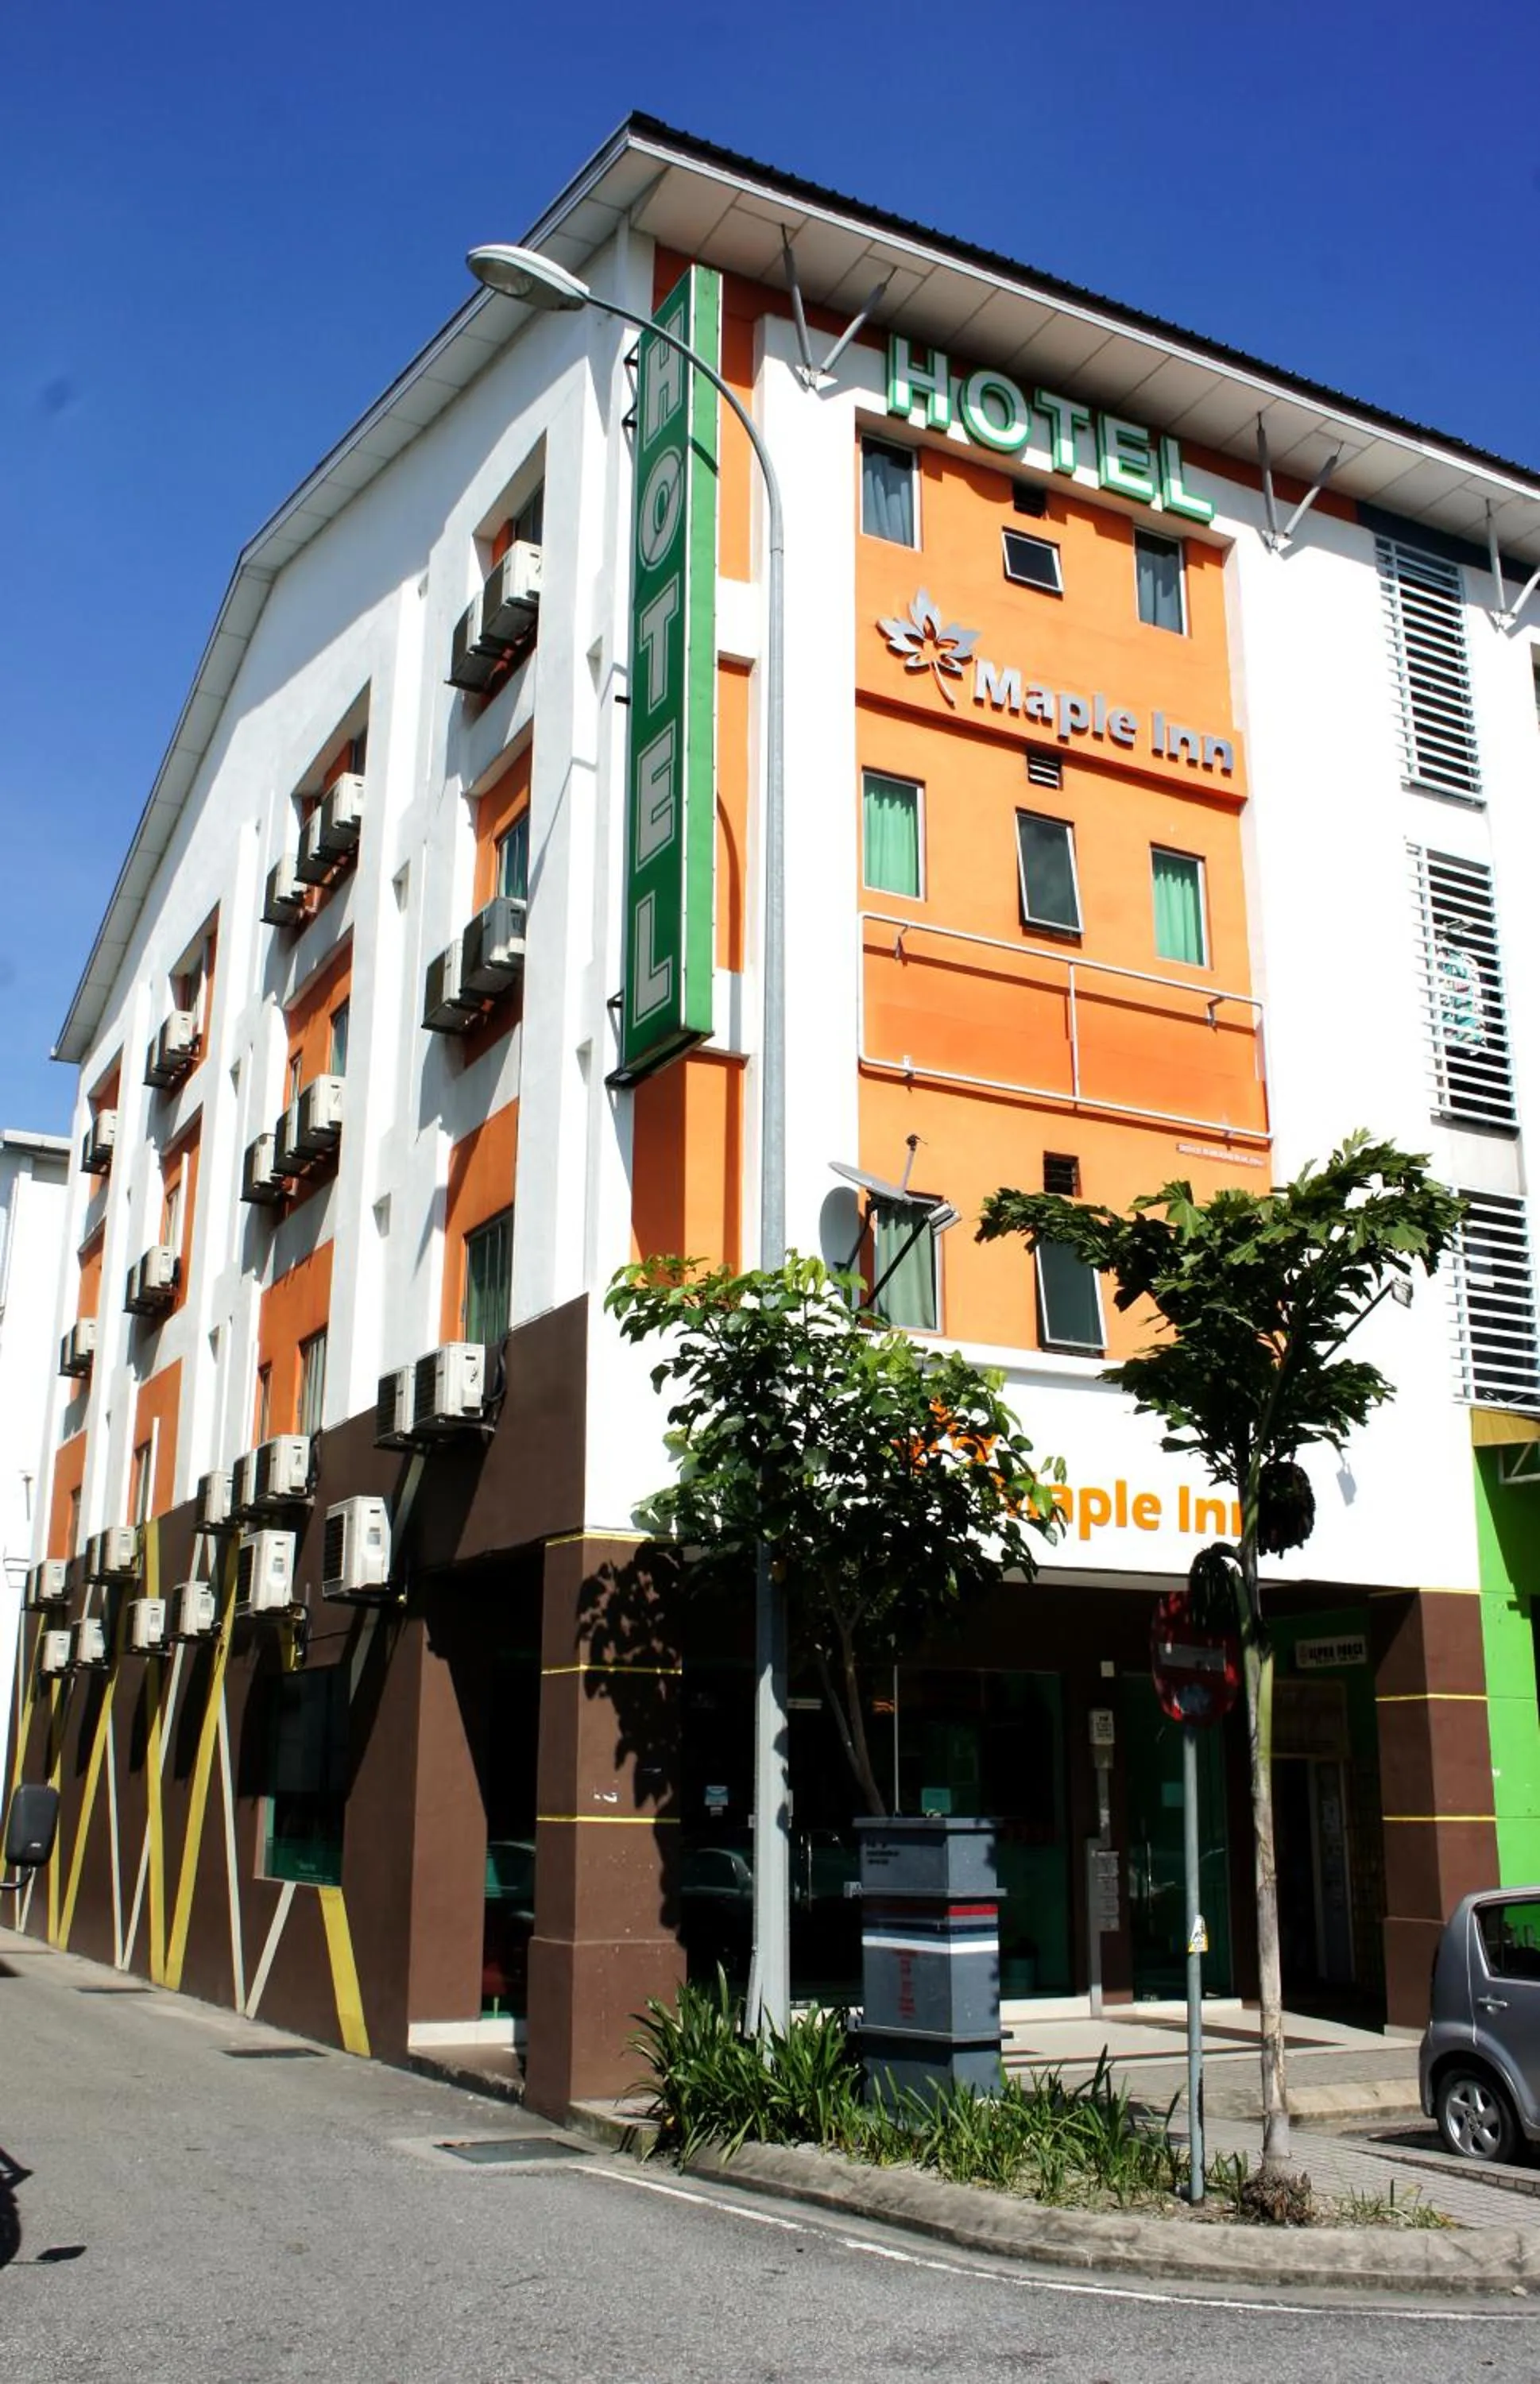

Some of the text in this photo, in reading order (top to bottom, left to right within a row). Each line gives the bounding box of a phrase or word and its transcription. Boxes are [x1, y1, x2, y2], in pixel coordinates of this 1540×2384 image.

[887, 332, 1215, 524] HOTEL
[633, 300, 685, 1028] HOTEL
[973, 658, 1234, 776] Maple Inn
